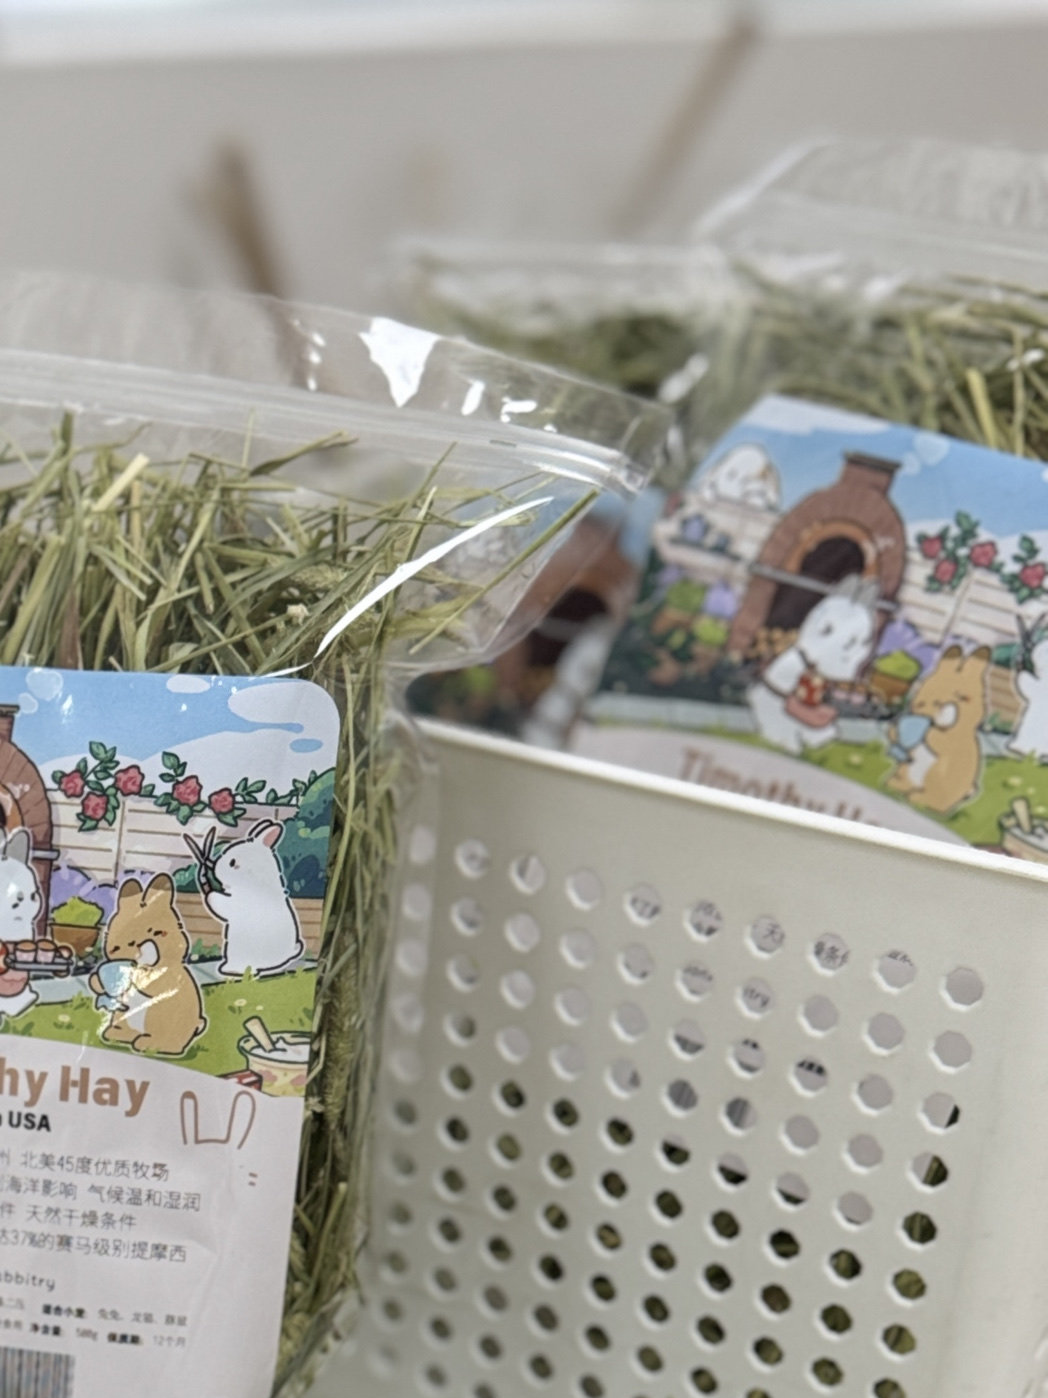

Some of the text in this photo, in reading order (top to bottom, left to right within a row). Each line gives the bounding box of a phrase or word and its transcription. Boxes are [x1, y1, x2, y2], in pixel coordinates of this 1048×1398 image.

[59, 1065, 150, 1117] Hay
[8, 1111, 52, 1133] USA
[21, 1150, 169, 1183] 北美45度优质牧场
[87, 1183, 201, 1213] 气候温和湿润
[25, 1204, 138, 1232] 天然干燥条件
